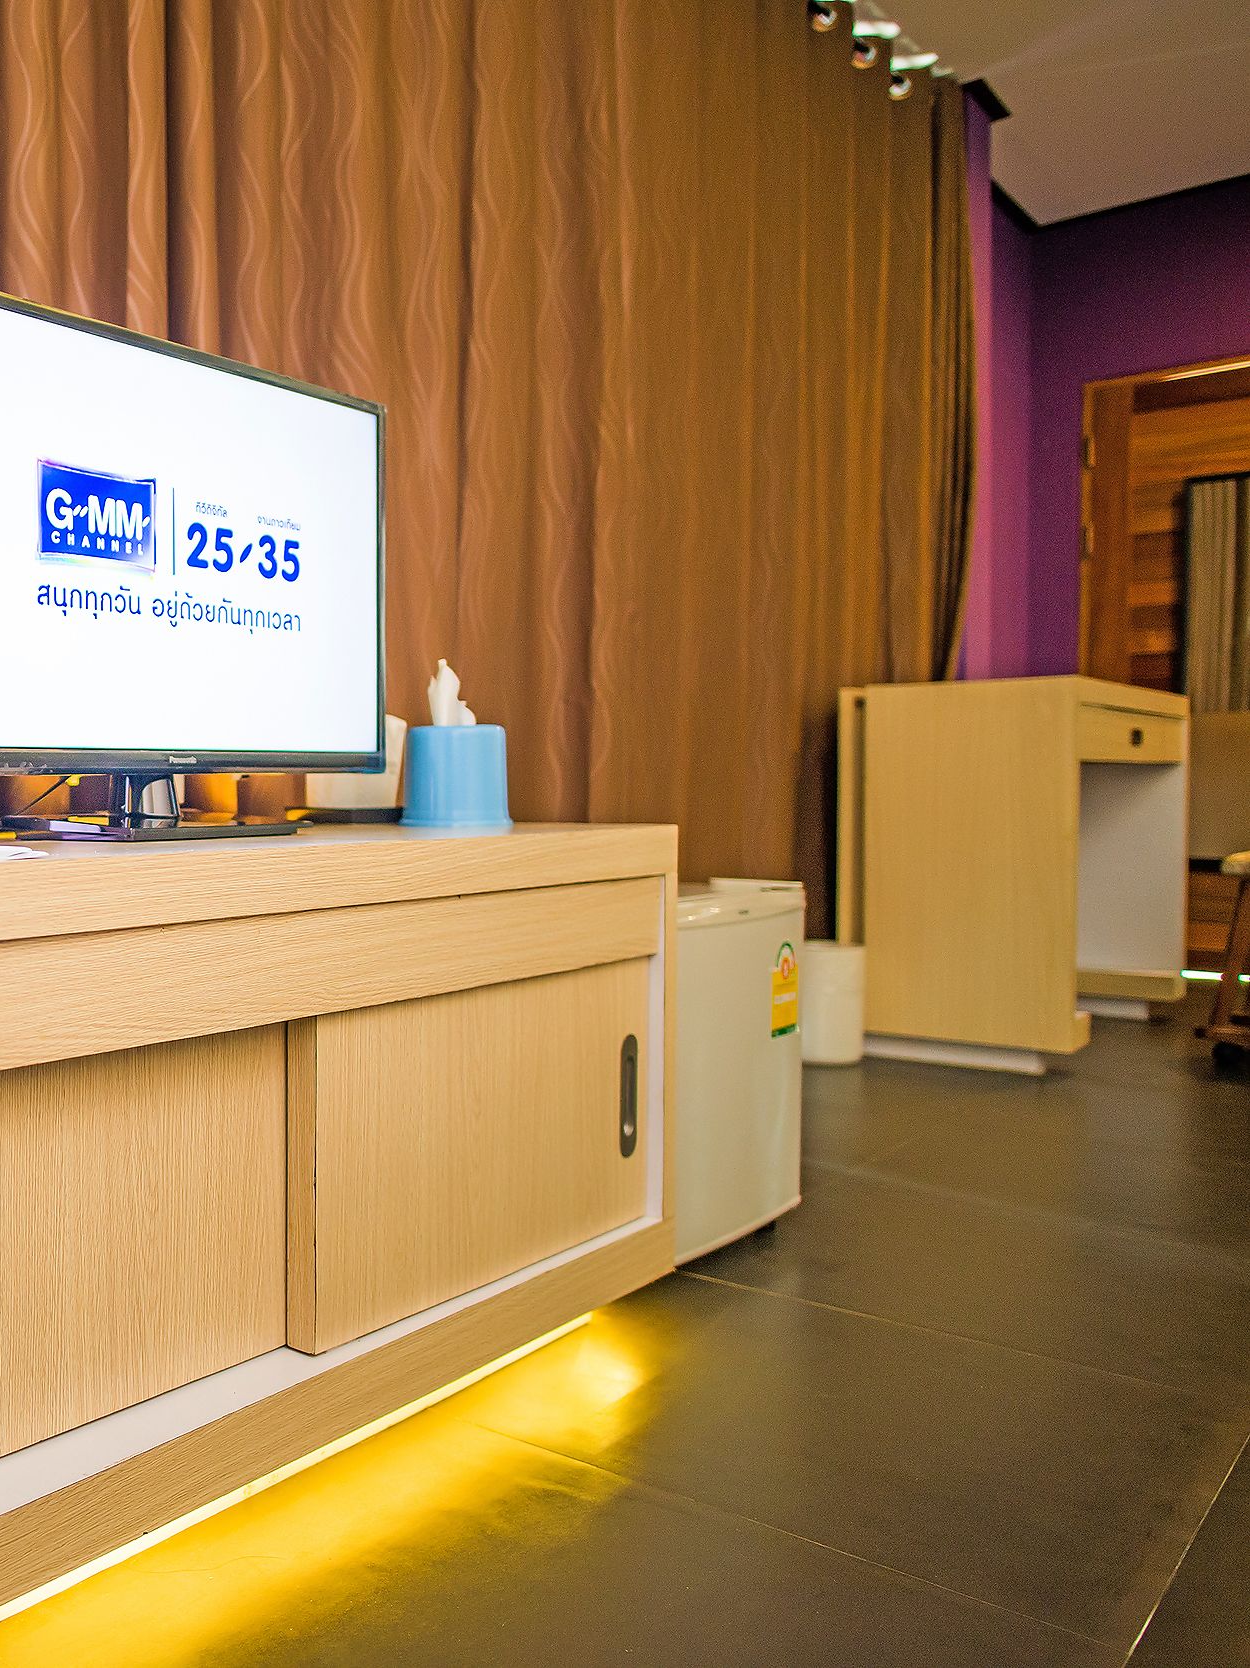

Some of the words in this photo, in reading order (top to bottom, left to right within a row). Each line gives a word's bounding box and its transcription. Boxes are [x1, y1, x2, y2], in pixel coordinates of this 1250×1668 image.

[51, 530, 145, 556] CHANNEL
[37, 583, 141, 619] สนุกทุกวัน
[152, 591, 301, 634] อยู่ด้วยกันทุกเวลา
